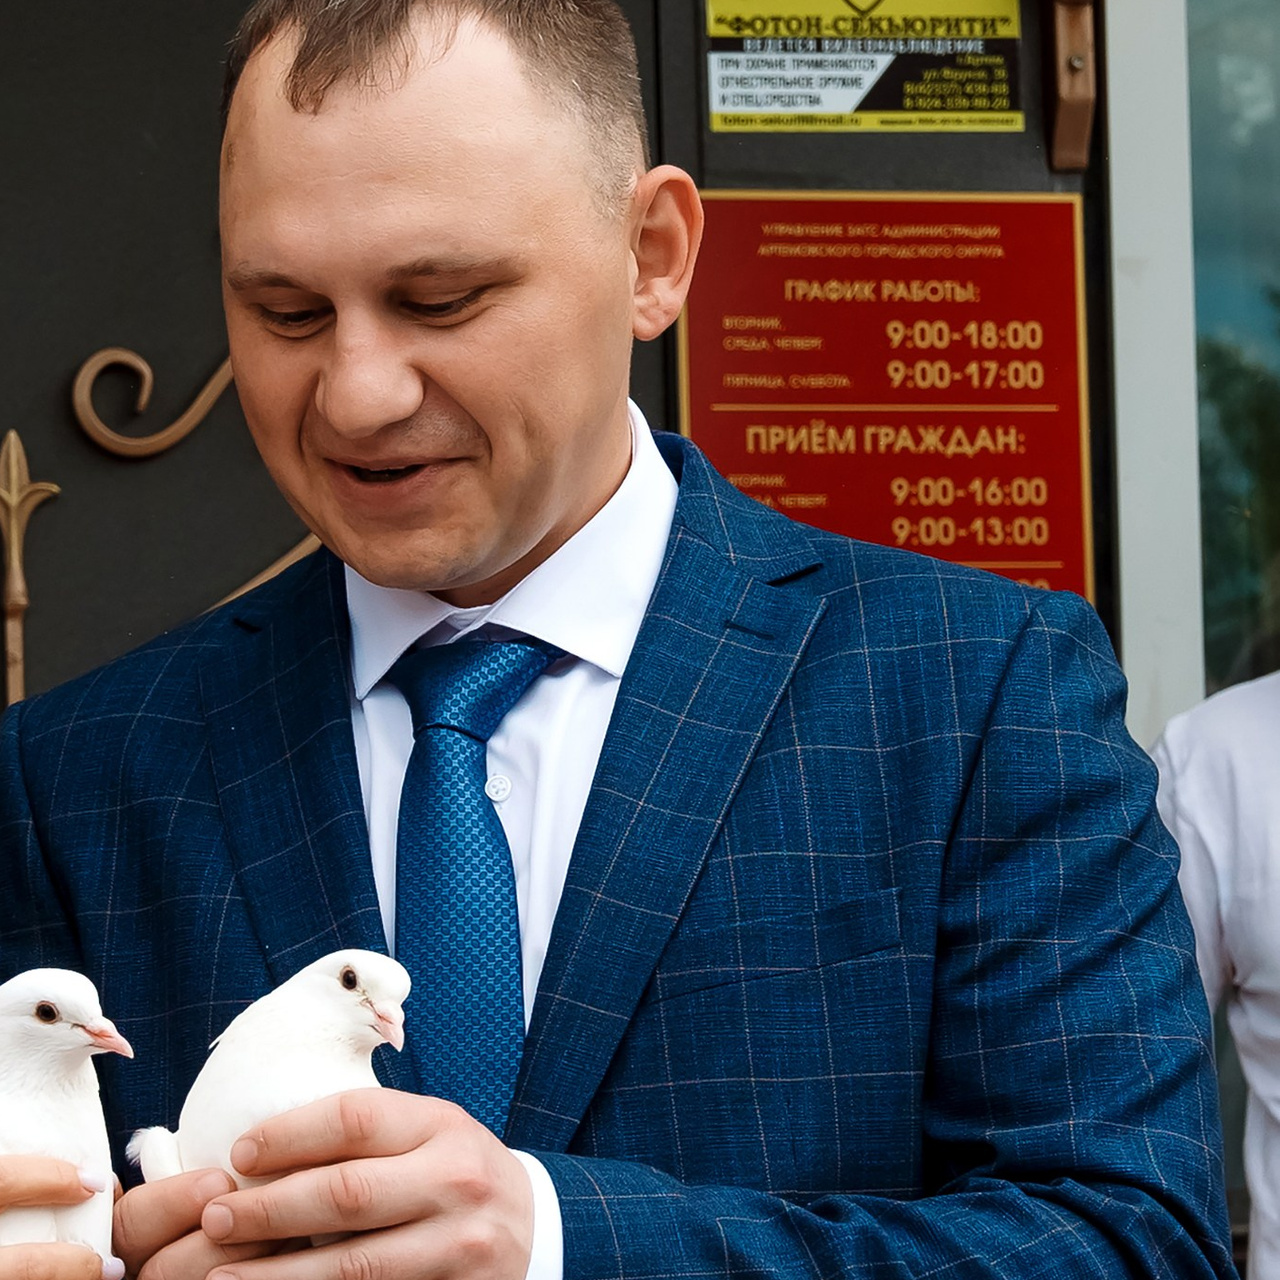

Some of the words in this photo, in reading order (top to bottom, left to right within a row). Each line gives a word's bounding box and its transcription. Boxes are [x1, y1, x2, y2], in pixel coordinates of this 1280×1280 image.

[784, 279, 876, 302] ГРАФИК
[881, 280, 980, 303] РАБОТЫ:
[885, 320, 1044, 351] 9:00-18:00
[886, 360, 1045, 390] 9:00-17:00
[745, 419, 856, 455] ПРИЁМ
[863, 424, 1026, 459] ГРАЖДАН:
[890, 477, 1048, 506] 9:00-16:00
[891, 516, 1050, 546] 9:00-13:00
